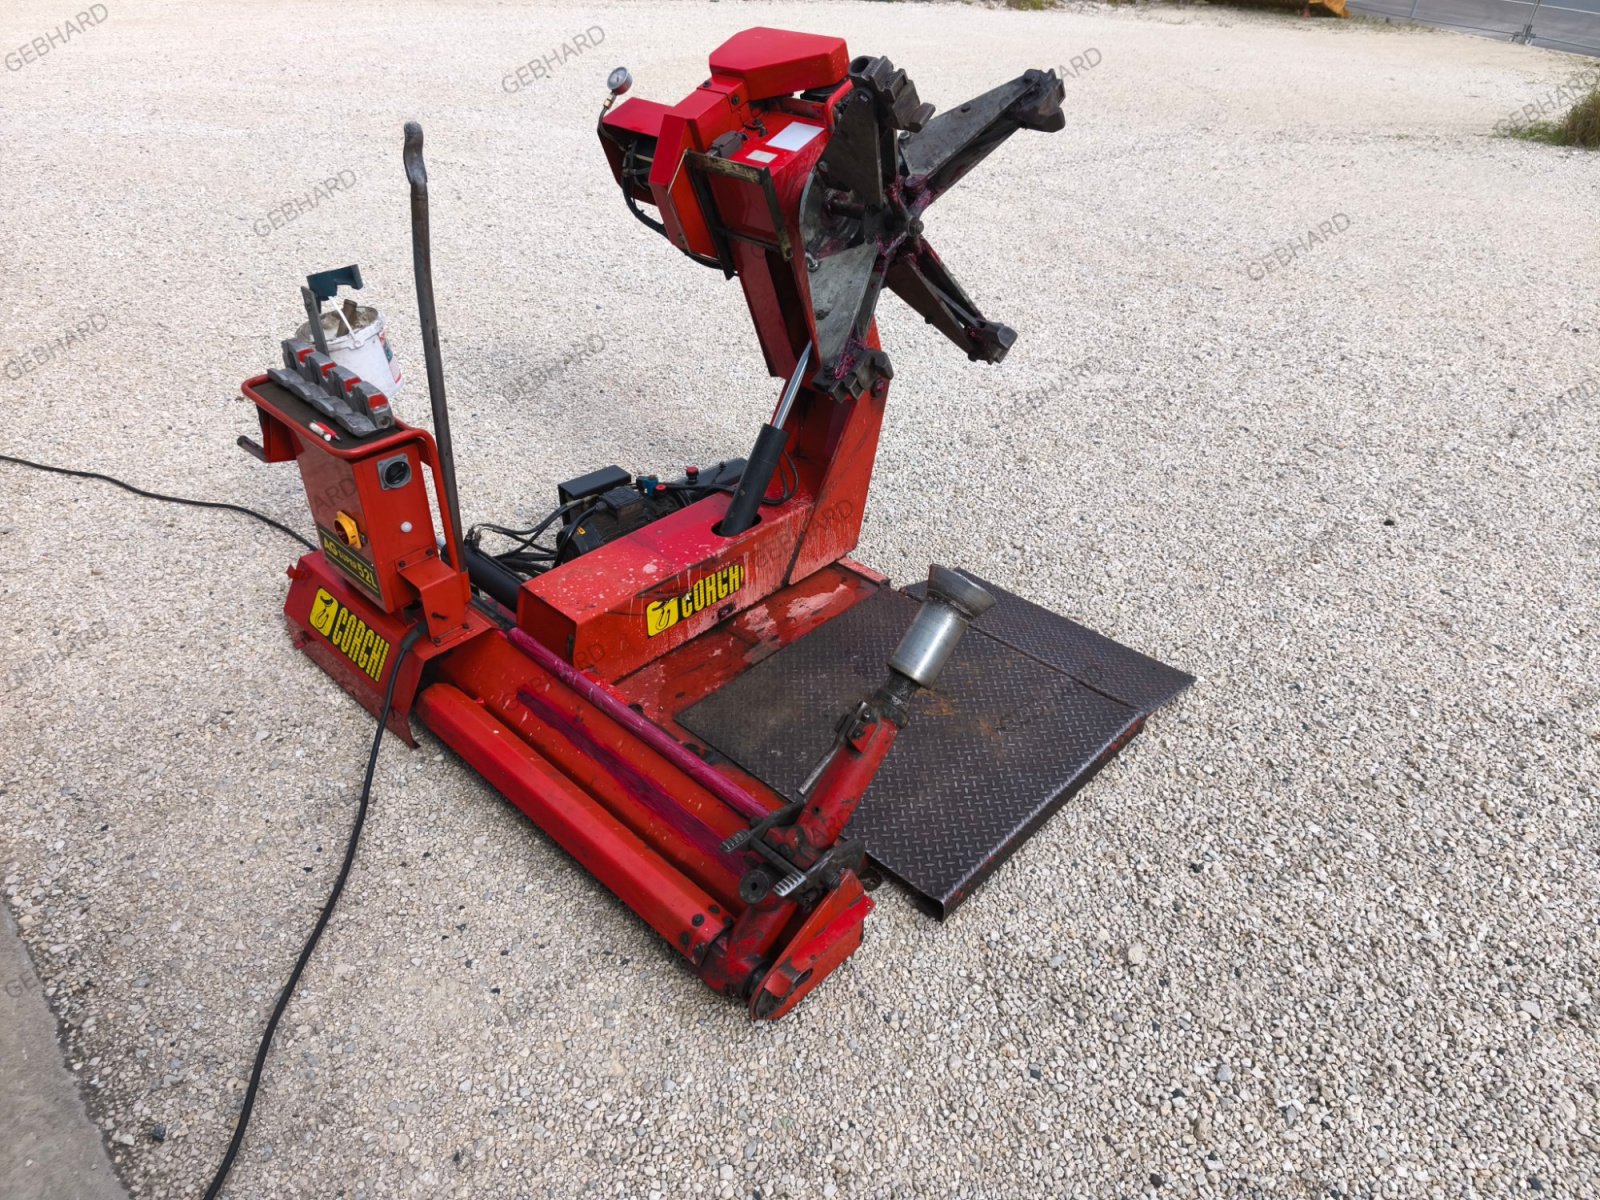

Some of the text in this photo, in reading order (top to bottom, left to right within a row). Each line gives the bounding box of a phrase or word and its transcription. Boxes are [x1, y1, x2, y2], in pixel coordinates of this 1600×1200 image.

[323, 536, 338, 556] AG
[356, 562, 378, 588] 52L
[332, 607, 391, 683] CORCHI
